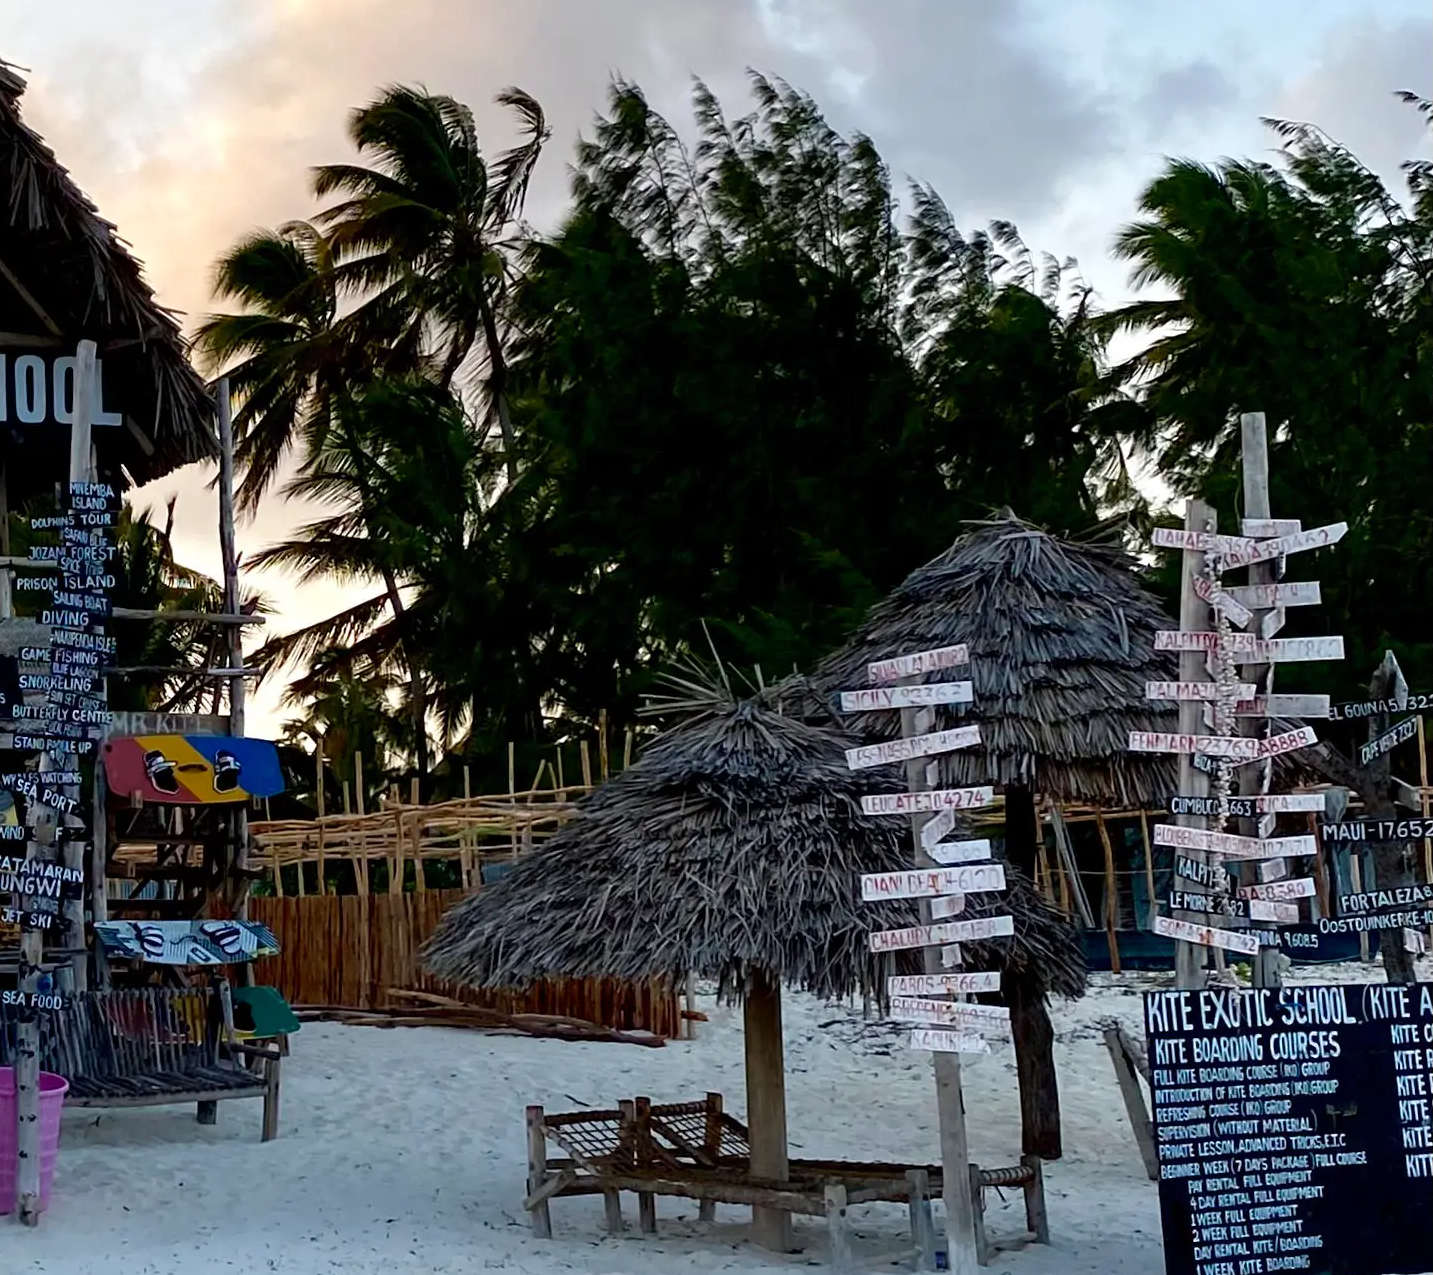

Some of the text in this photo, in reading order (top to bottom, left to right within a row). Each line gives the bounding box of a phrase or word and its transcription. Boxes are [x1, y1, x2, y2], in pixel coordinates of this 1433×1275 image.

[72, 496, 106, 510] ISLAND
[80, 513, 111, 526] TOUR
[71, 546, 116, 562] FOREST
[17, 574, 116, 591] PRISON ISLAND
[42, 610, 89, 626] DIVING
[21, 648, 98, 665] GAME FISHING
[19, 675, 91, 691] SNORKELING
[13, 704, 69, 722] BUTTERFLY
[1345, 701, 1389, 719] GOUNA
[14, 736, 92, 754] STAND UP
[16, 778, 77, 813] SEA PORT
[1170, 891, 1181, 909] LE
[1341, 886, 1424, 913] FORTALEZA
[1, 908, 52, 929] JET SKI
[871, 927, 932, 951] CHALUPY
[2, 991, 62, 1010] SEA FOOD
[1148, 986, 1358, 1033] KITE EXOTIC SCHOOL
[1390, 1024, 1419, 1044] KITE
[1155, 1030, 1342, 1066] KITE BOARDING COURSES
[1394, 1049, 1423, 1070] KITE
[1154, 1069, 1174, 1086] FULL
[1177, 1069, 1197, 1084] KITE
[1199, 1066, 1245, 1083] BOARDING
[1397, 1074, 1427, 1096] KITE
[1215, 1087, 1226, 1100] OF
[1399, 1098, 1429, 1121] KITE
[1402, 1126, 1433, 1148] KITE
[1203, 1160, 1229, 1175] WEEK
[1244, 1157, 1268, 1172] DAYS
[1406, 1153, 1433, 1177] KIT
[1198, 1195, 1216, 1210] DAY
[1197, 1211, 1222, 1227] WEEK
[1225, 1209, 1246, 1224] FULL
[1192, 1228, 1200, 1243] 2
[1201, 1227, 1228, 1241] WEEK
[1230, 1225, 1250, 1239] FULL
[1194, 1242, 1250, 1261] DAY RENTAL
[1239, 1259, 1263, 1275] KITE
